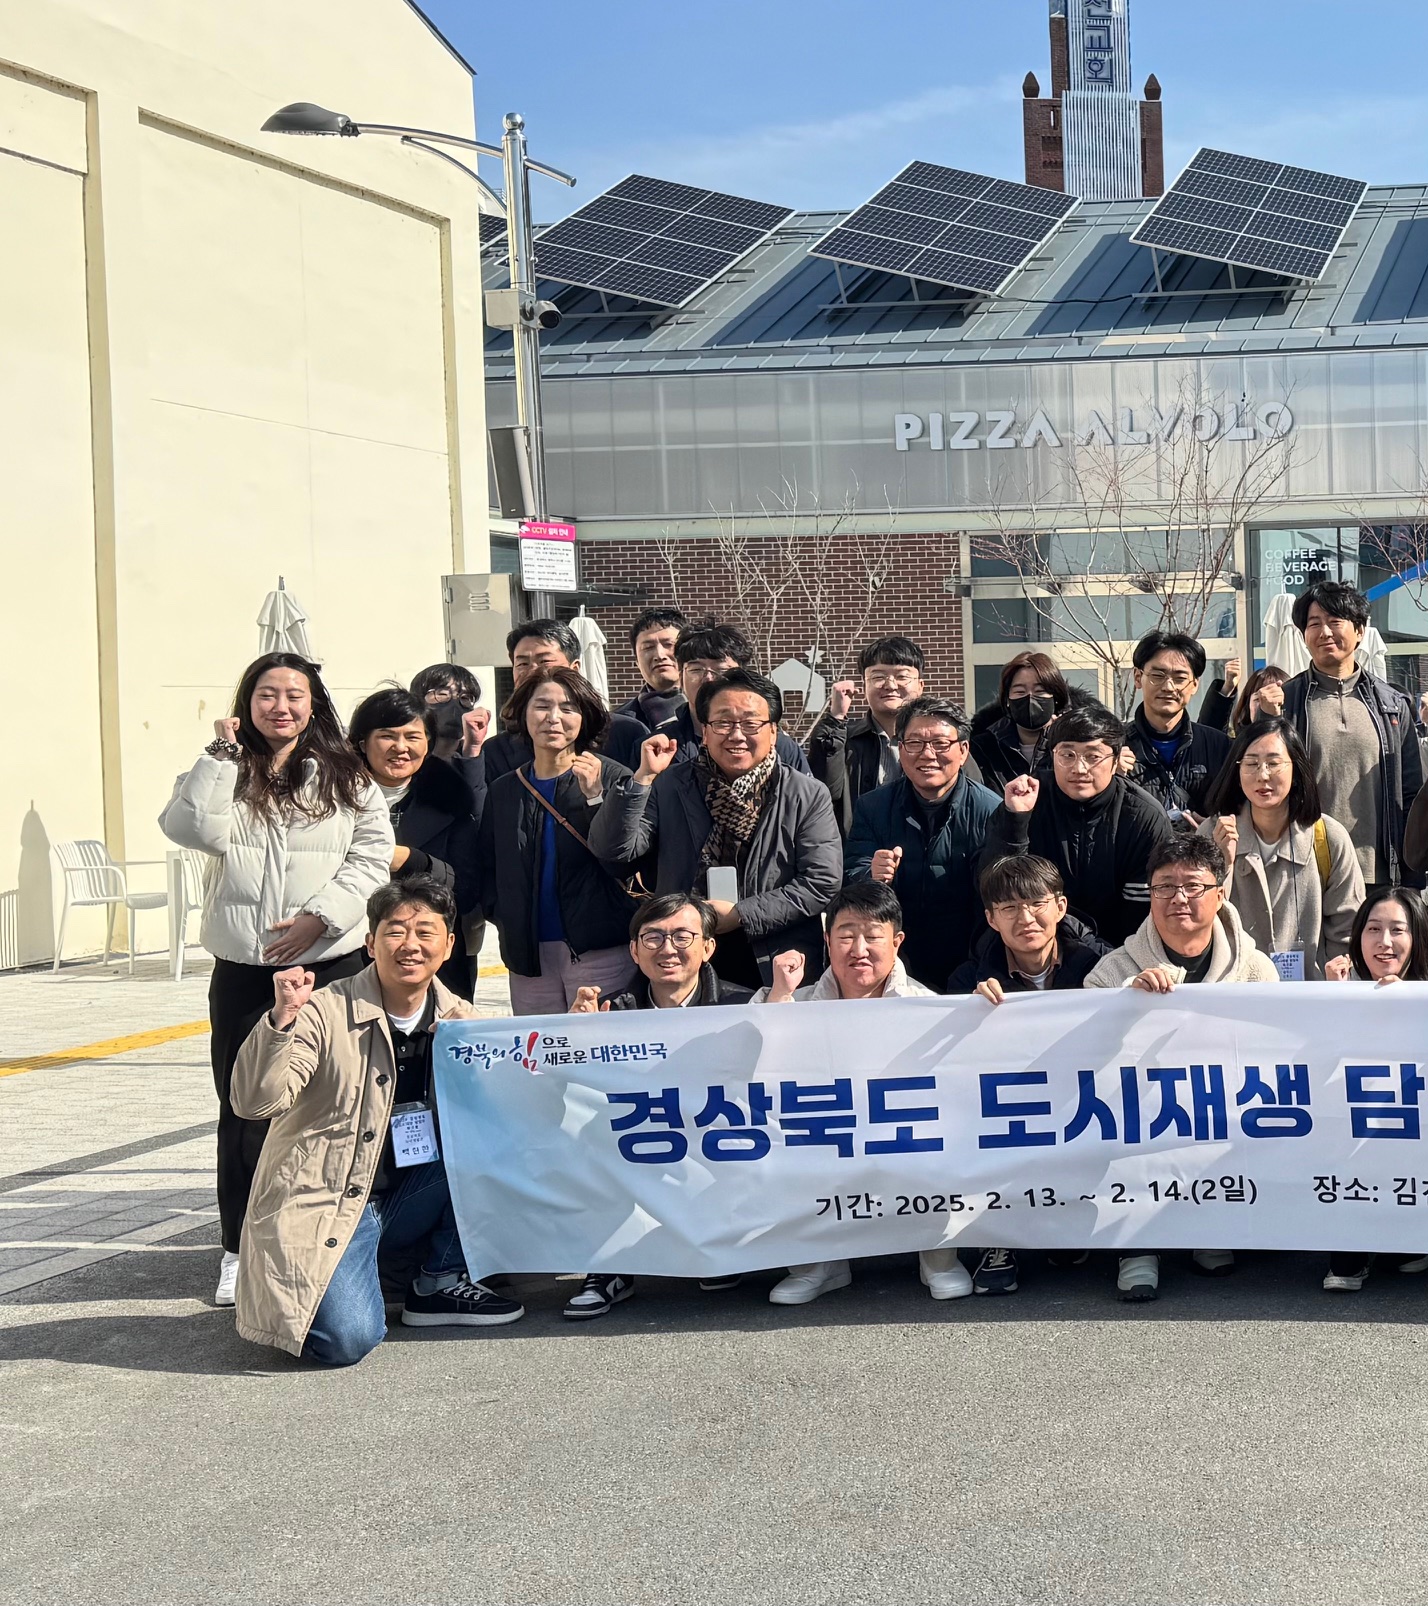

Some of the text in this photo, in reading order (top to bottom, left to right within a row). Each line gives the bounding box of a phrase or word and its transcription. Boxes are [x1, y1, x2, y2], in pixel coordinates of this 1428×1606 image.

[895, 401, 1294, 451] PIZZA ALVOLO
[1264, 548, 1317, 560] COFFEE
[1265, 561, 1337, 572] BEVERAGE
[1266, 574, 1305, 585] FOOD
[447, 1042, 506, 1070] 경북의
[543, 1042, 668, 1066] 새로운 대한민국
[606, 1076, 944, 1165] 경상북도
[979, 1064, 1313, 1150] 도시재생
[815, 1193, 884, 1221] 기간:
[896, 1193, 975, 1216] 2025.
[987, 1191, 1010, 1210] 2.
[1024, 1187, 1066, 1208] 13.
[1111, 1183, 1135, 1204] 2.
[1148, 1175, 1258, 1205] 14.(2일)
[1313, 1175, 1379, 1204] 장소:
